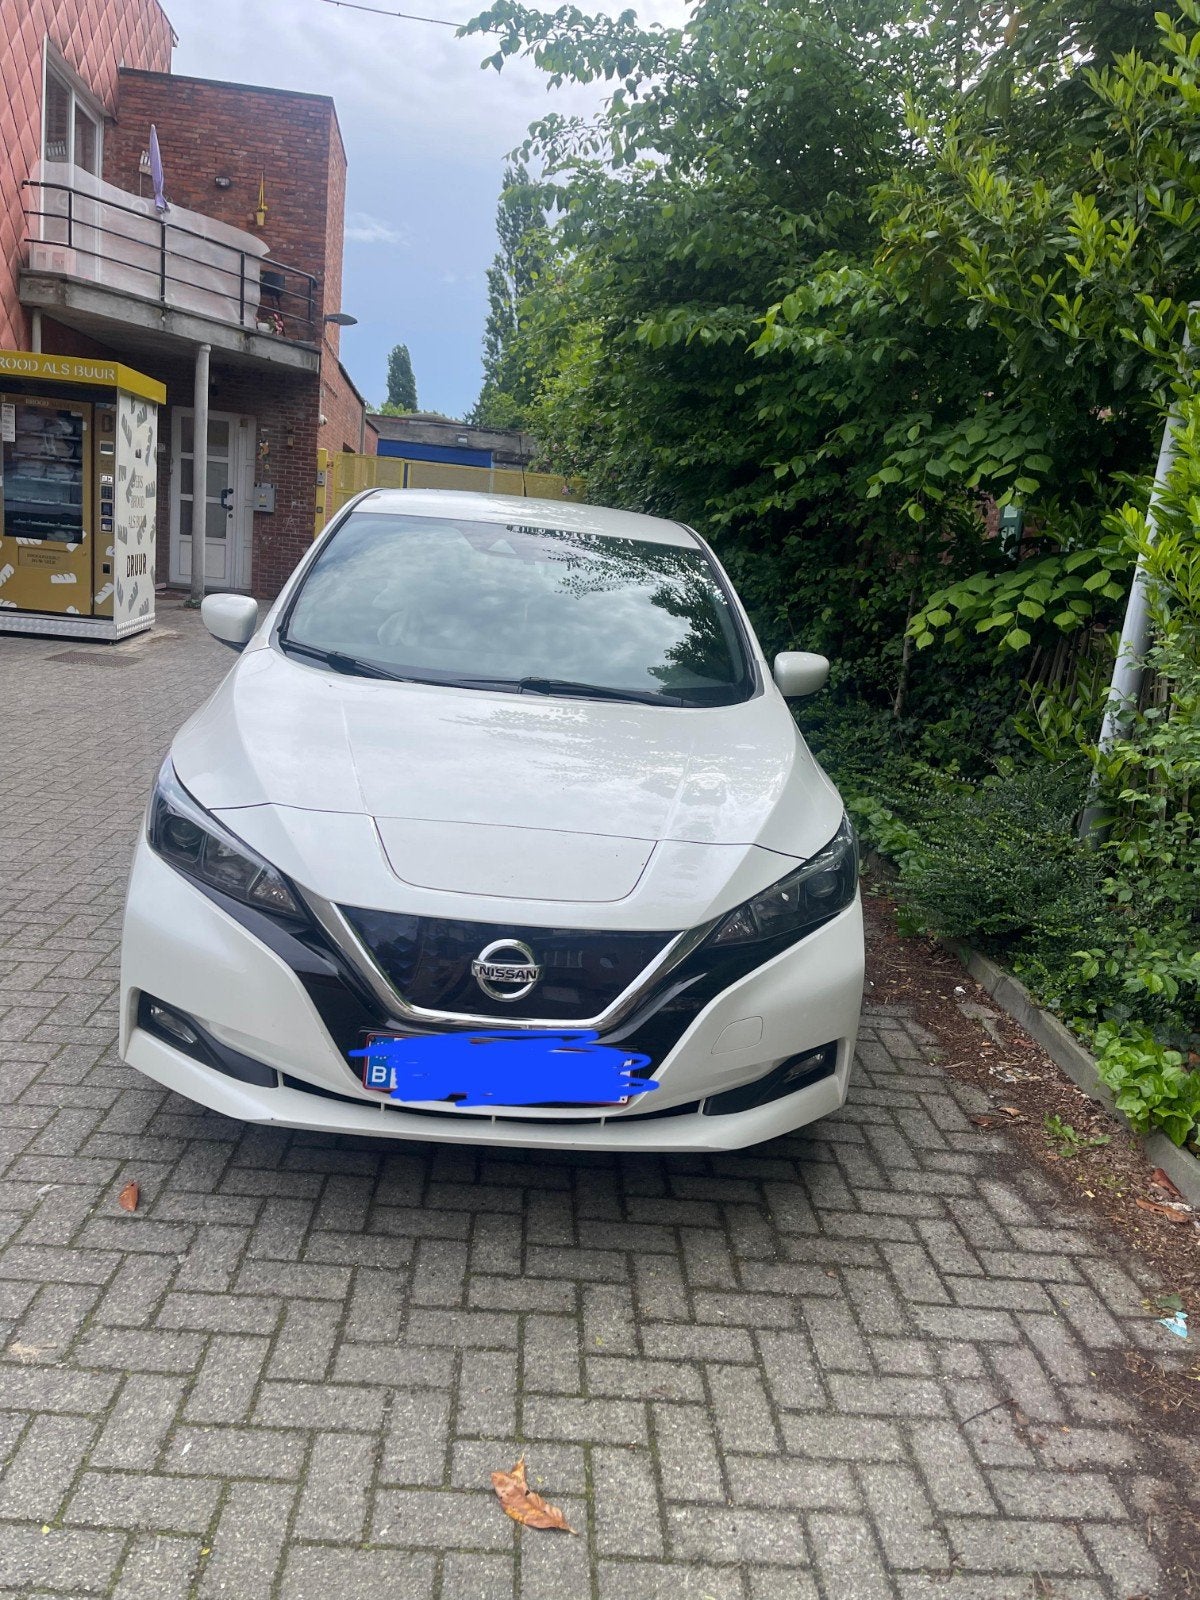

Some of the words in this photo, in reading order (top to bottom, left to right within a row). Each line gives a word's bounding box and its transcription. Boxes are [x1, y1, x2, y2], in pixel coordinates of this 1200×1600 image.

[43, 362, 70, 376] ALS
[74, 365, 115, 380] BUUR
[126, 553, 147, 578] DRUUR
[479, 966, 537, 980] NISSAN
[371, 1066, 387, 1083] B
